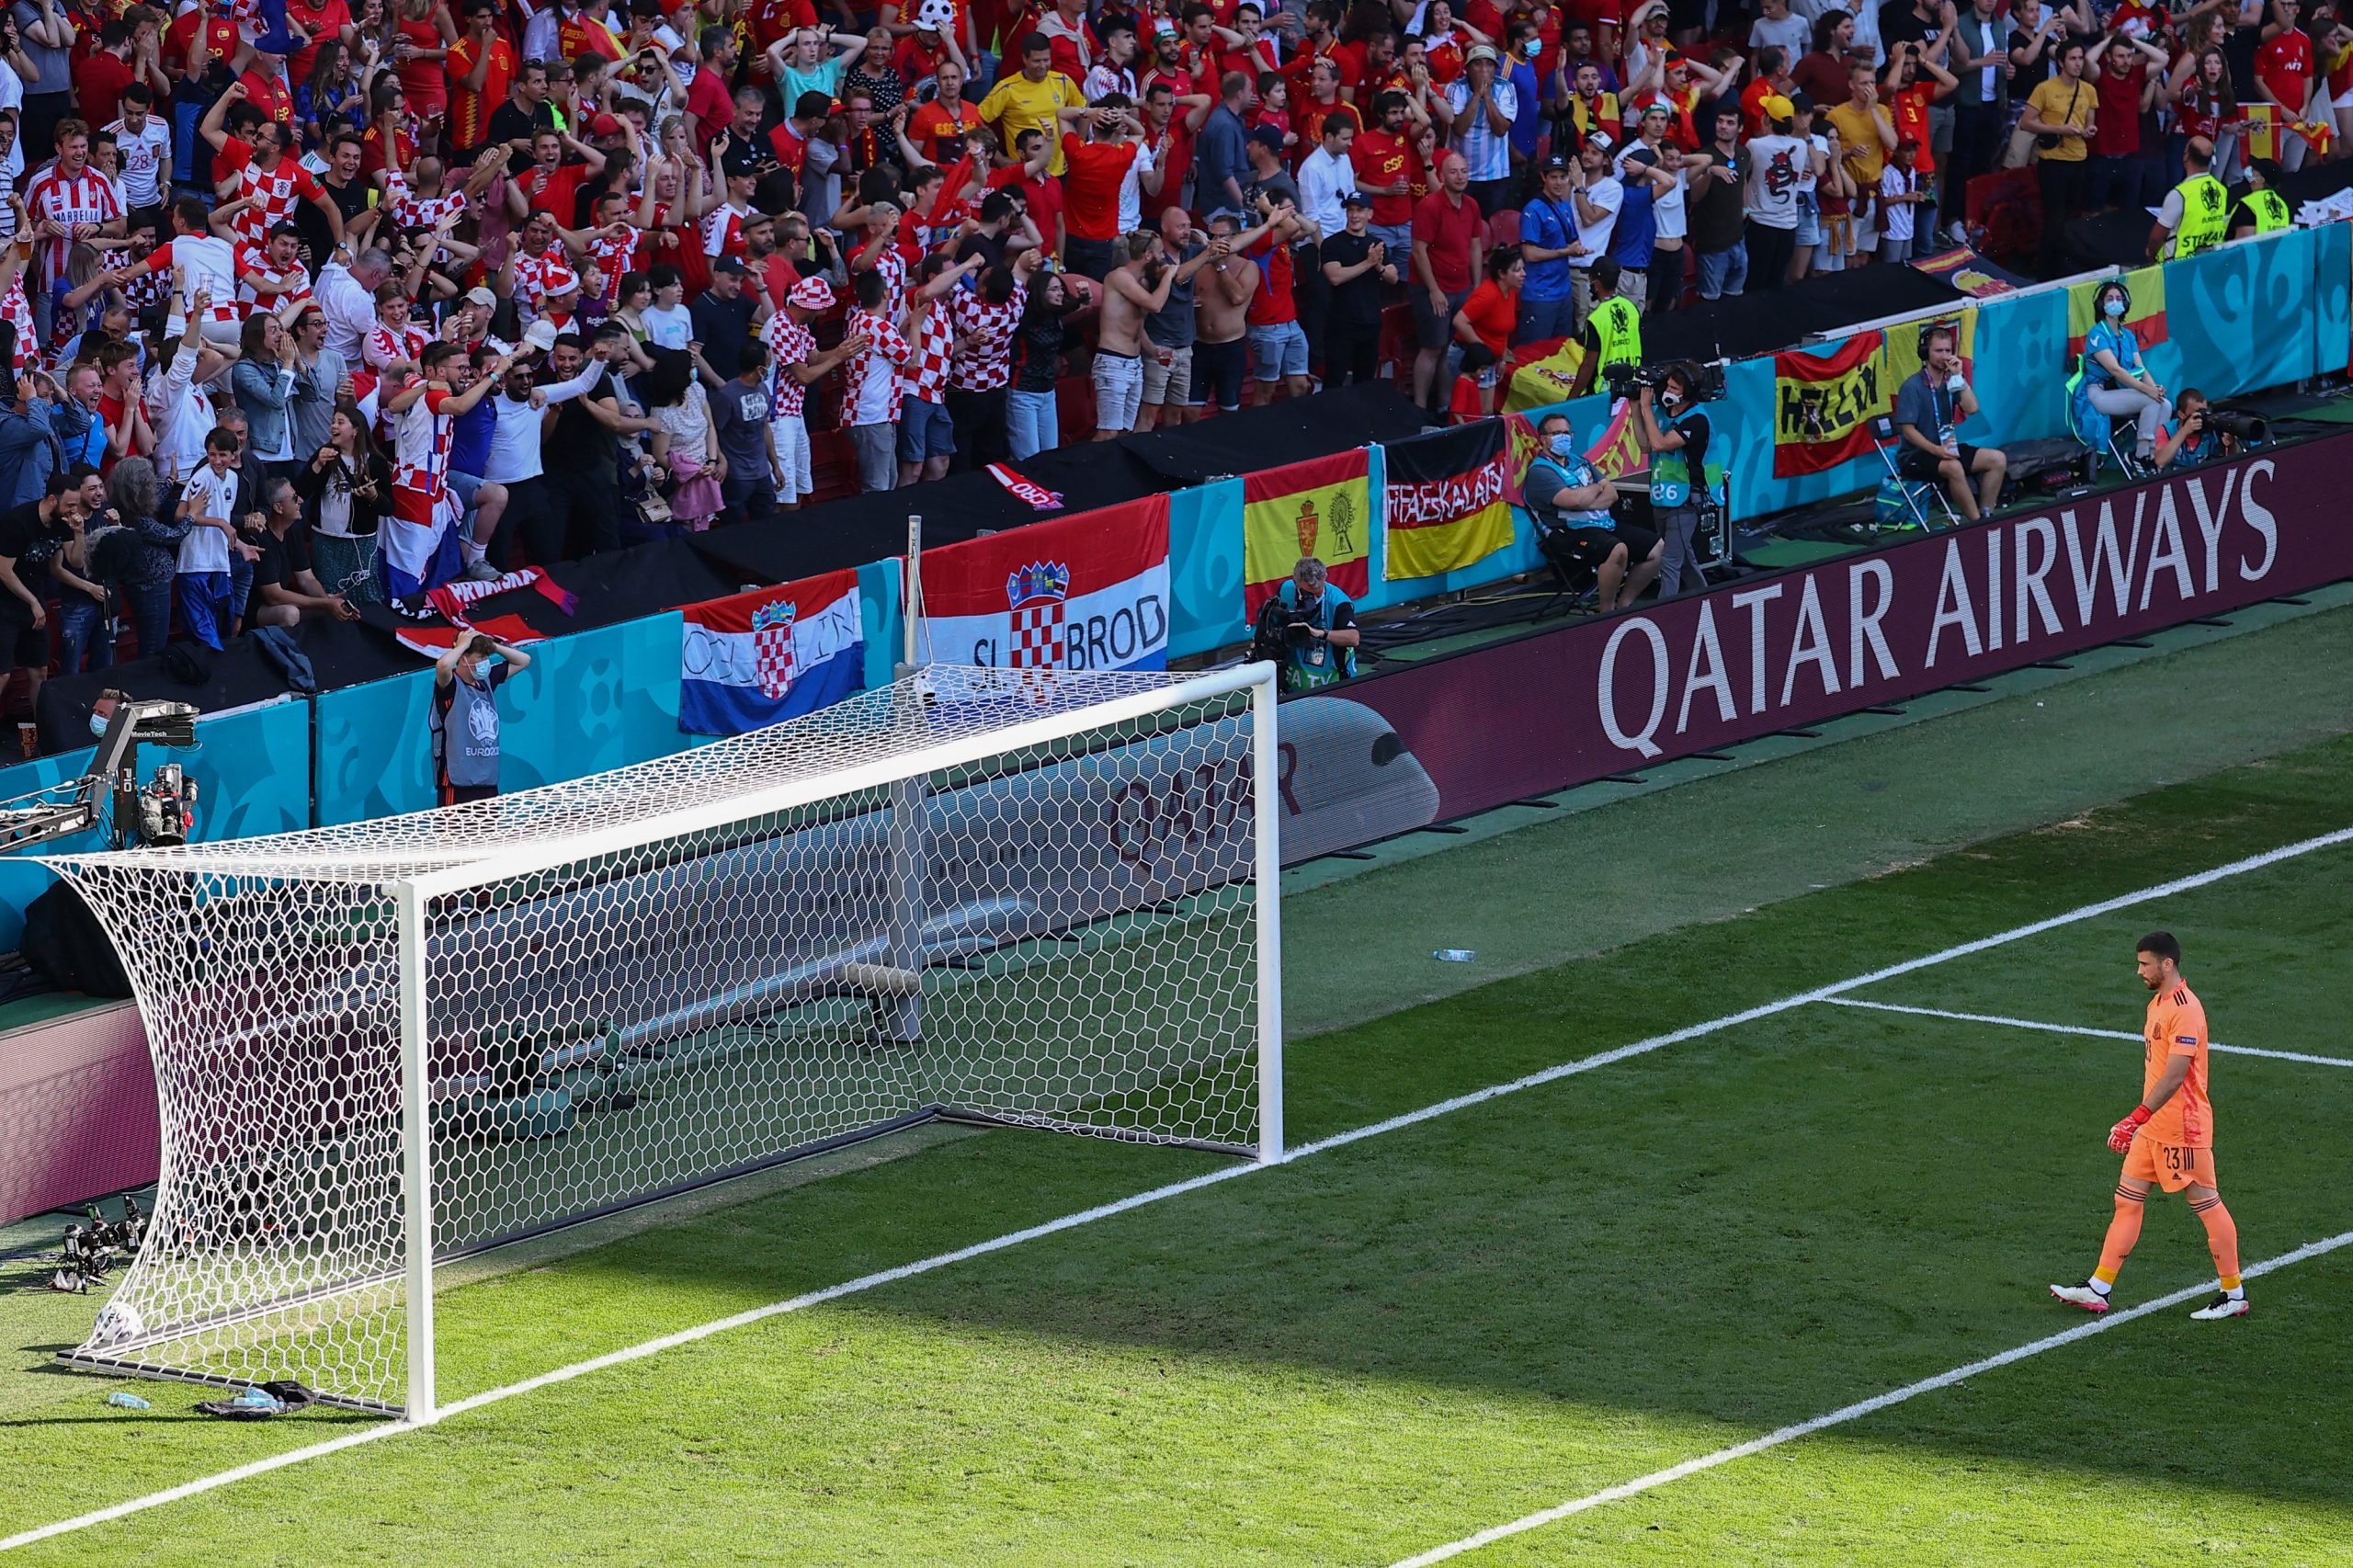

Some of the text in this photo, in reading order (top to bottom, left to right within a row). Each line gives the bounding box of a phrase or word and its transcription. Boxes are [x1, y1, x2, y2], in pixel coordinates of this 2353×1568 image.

[1906, 108, 1919, 122] 9
[131, 154, 150, 171] 28
[1383, 154, 1404, 173] ESP
[52, 210, 98, 223] MARBELLA
[1012, 483, 1050, 505] CRO
[1597, 459, 2279, 760] QATAR AIRWAYS
[1067, 595, 1166, 676] BROD
[2164, 1147, 2180, 1170] 23
